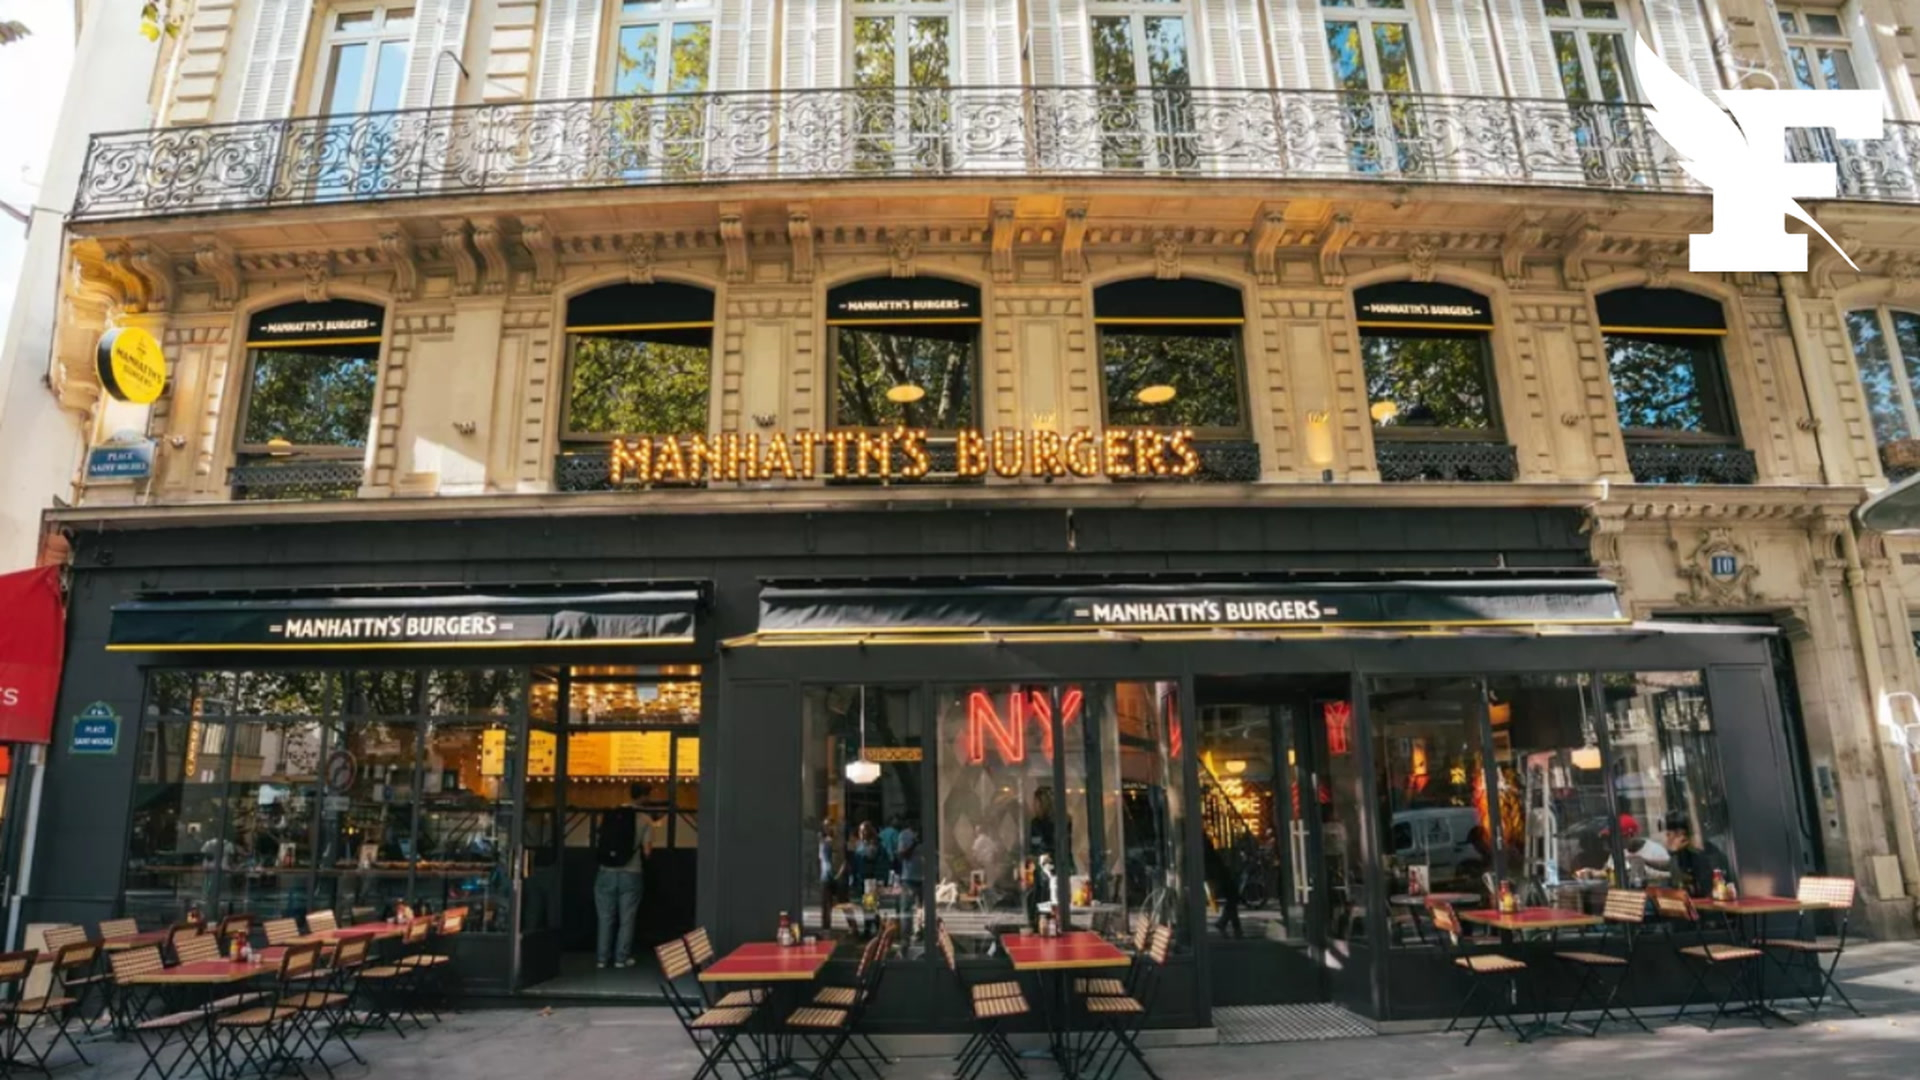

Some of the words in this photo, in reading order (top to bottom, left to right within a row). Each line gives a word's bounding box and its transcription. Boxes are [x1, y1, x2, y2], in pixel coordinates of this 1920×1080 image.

[847, 300, 910, 310] MANHATTN'S
[912, 299, 960, 310] BURGERS
[1370, 303, 1429, 315] MANHATTN'S
[1430, 305, 1474, 316] BURGERS
[267, 320, 324, 333] MANHATTN'S
[325, 319, 369, 331] BURGERS
[107, 452, 133, 461] PLACE
[609, 425, 929, 482] MANHATTN'S
[956, 427, 1200, 478] BURGERS
[1716, 557, 1734, 574] 10
[1092, 600, 1222, 622] MANHATTN'S
[1225, 600, 1321, 621] BURGERS
[284, 615, 402, 638] MANHATTN'S
[405, 615, 497, 636] BURGERS
[84, 725, 107, 734] PLACE
[969, 690, 1083, 763] NY
